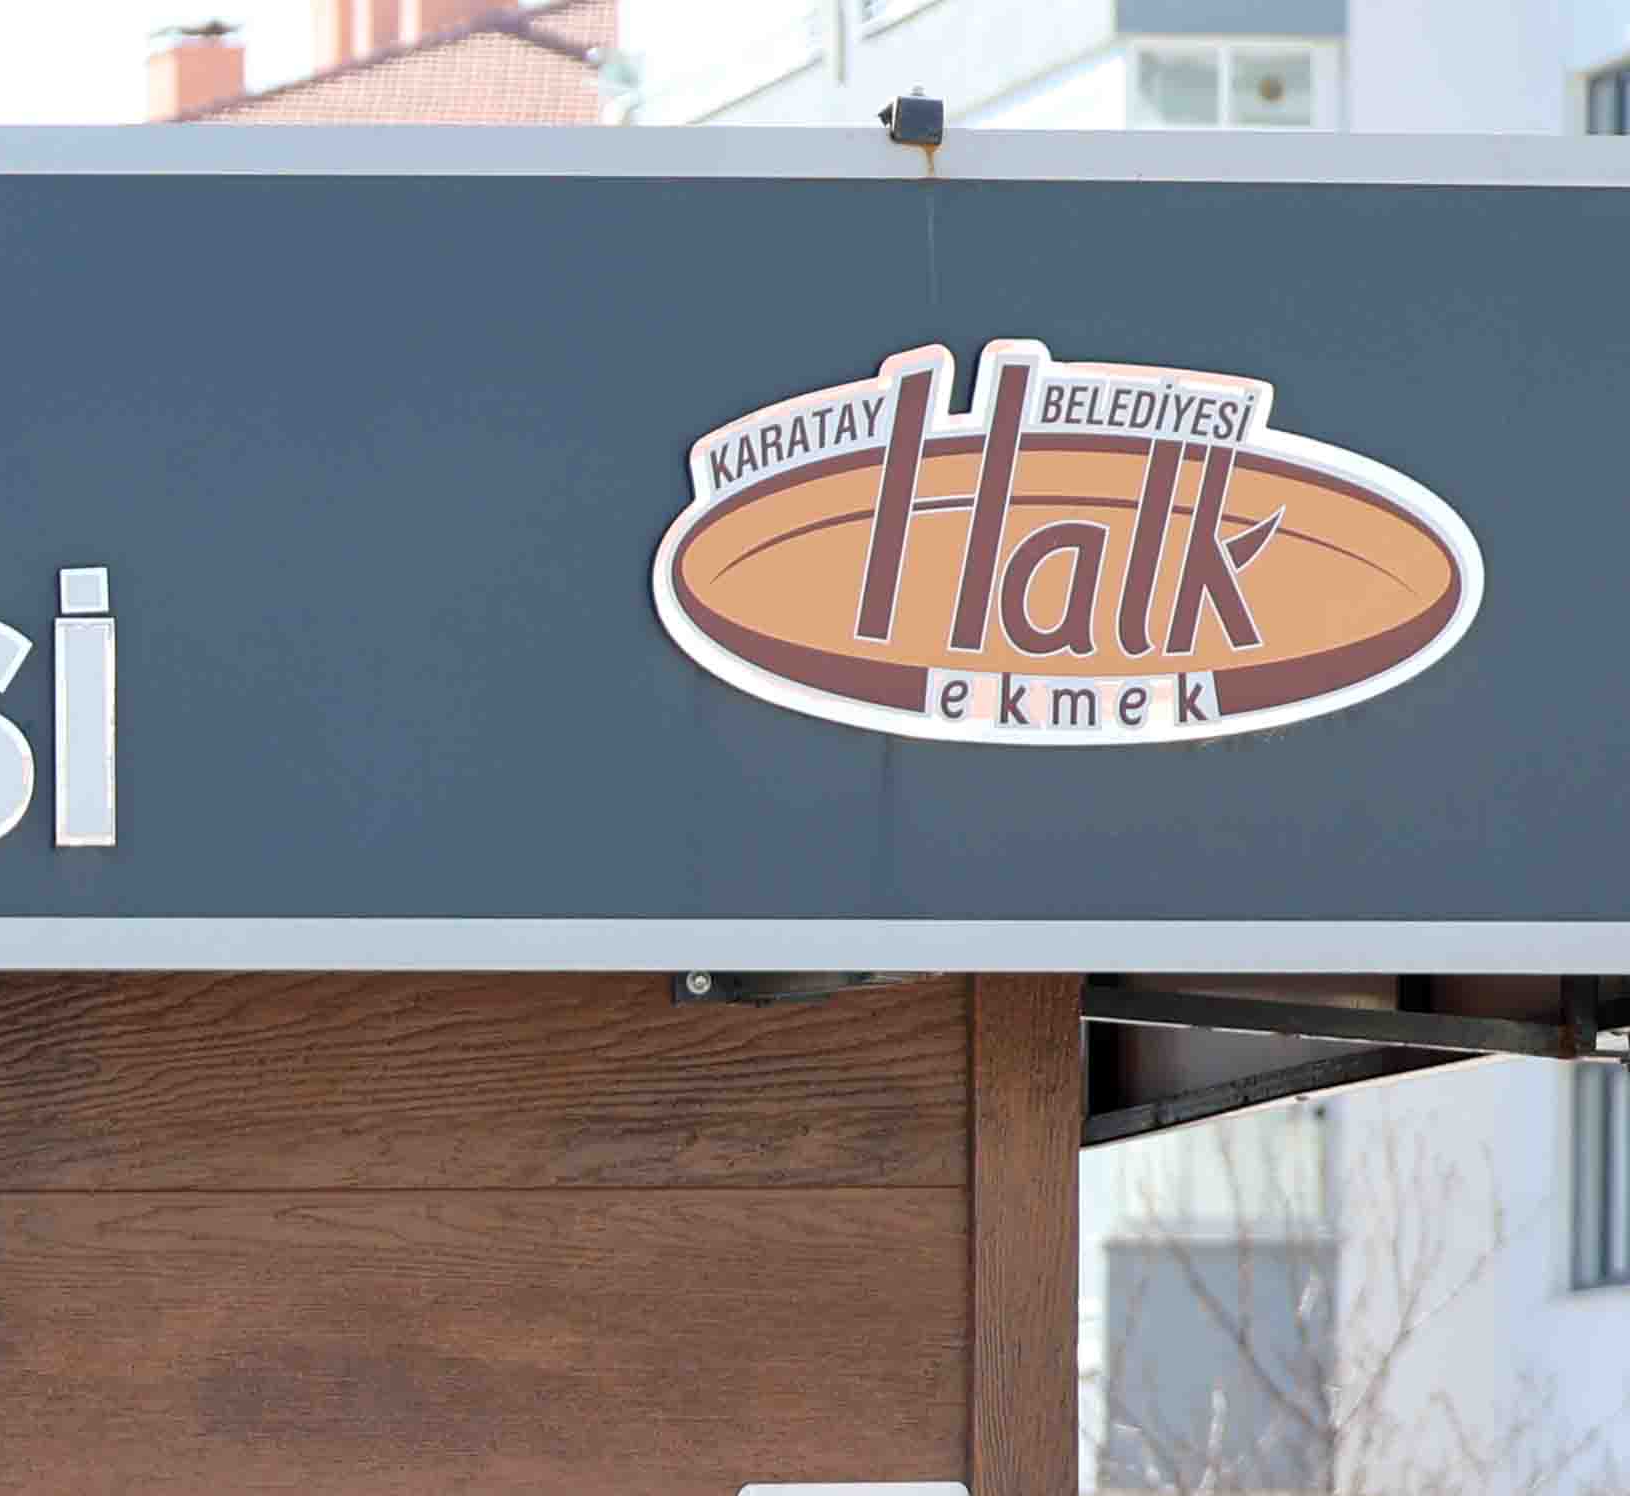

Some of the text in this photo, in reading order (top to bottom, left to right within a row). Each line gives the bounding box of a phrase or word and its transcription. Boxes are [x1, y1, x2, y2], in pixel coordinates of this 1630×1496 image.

[710, 396, 885, 490] KARATAY
[1040, 380, 1256, 443] BELEDİYESİ
[855, 359, 1287, 656] Halk
[940, 671, 1206, 725] ekmek
